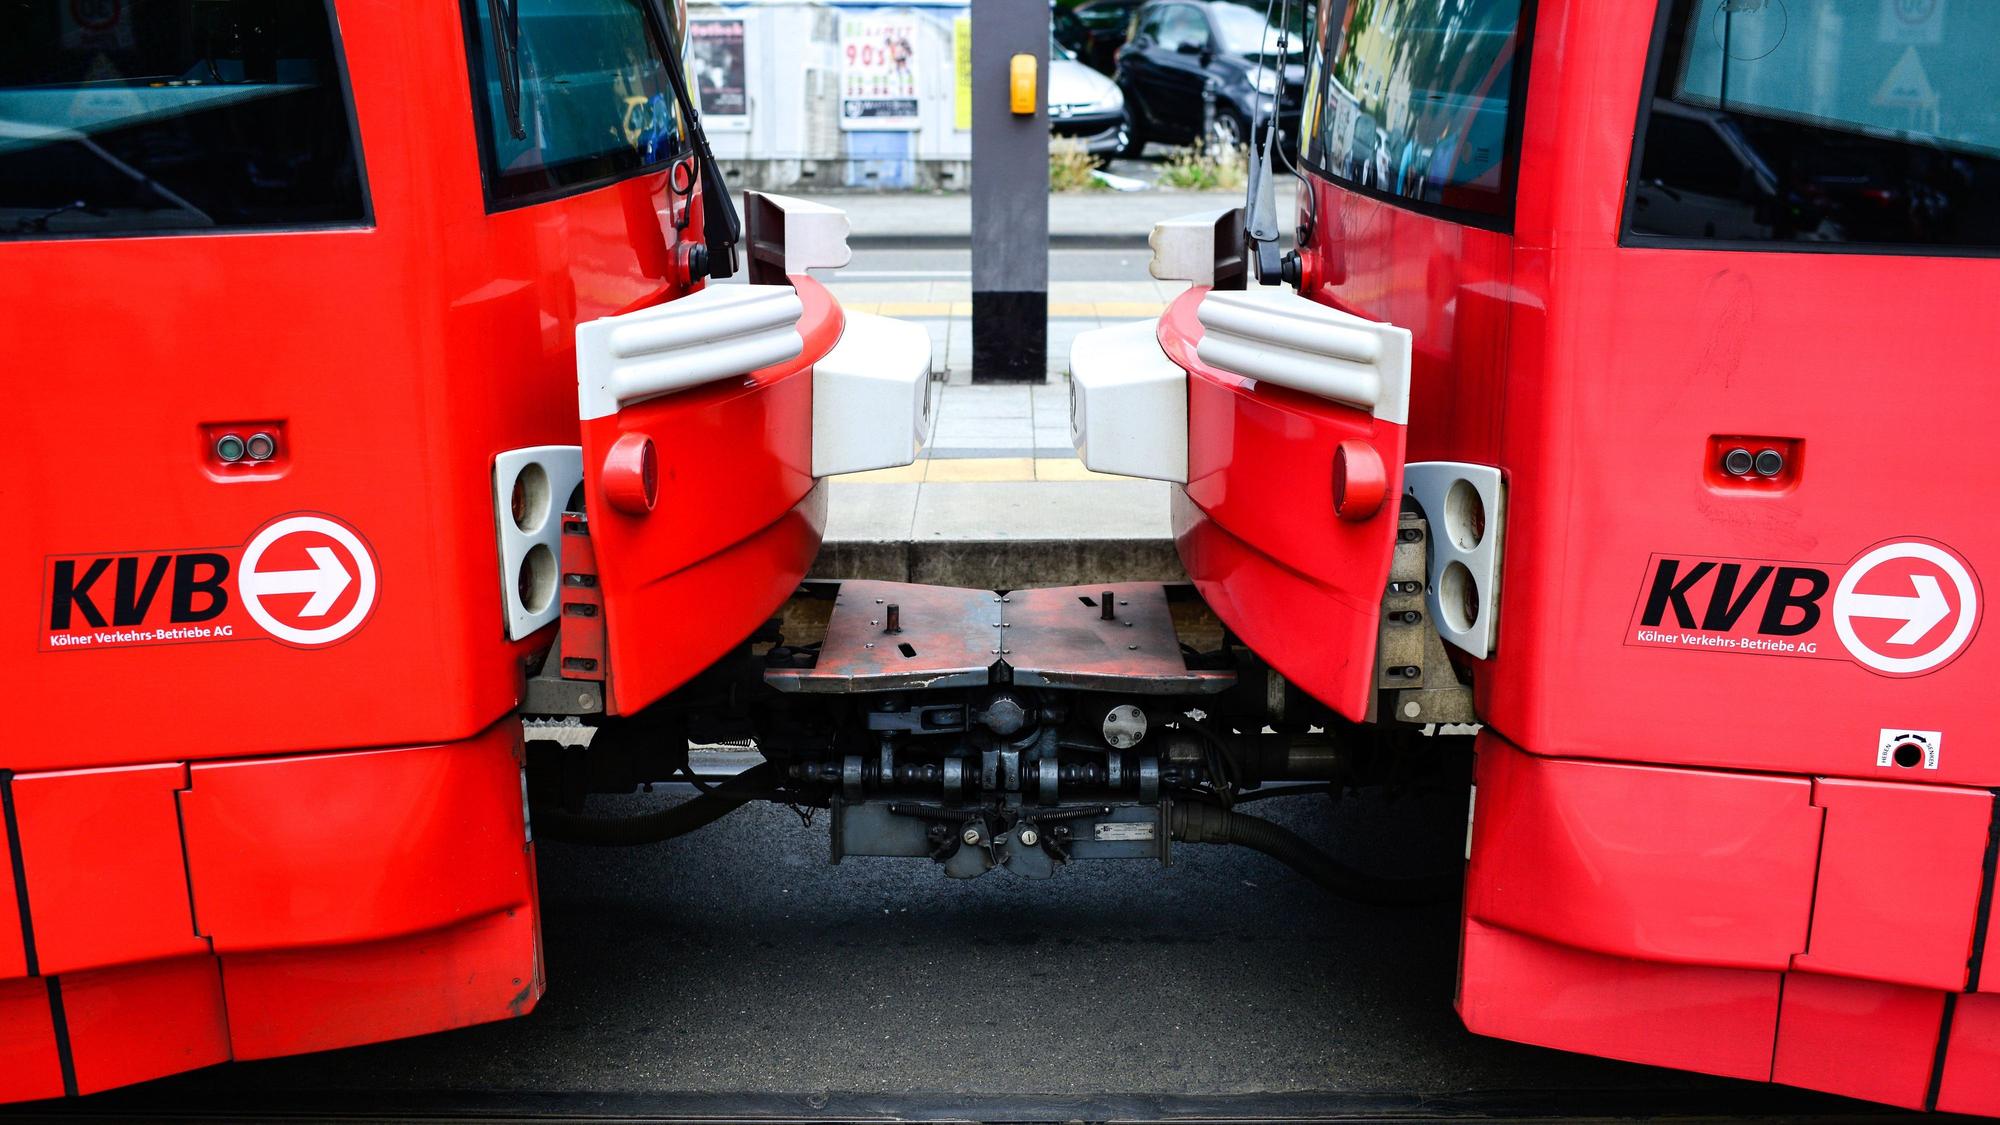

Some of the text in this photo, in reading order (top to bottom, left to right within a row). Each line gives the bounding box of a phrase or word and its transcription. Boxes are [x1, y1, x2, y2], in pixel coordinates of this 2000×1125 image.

[51, 553, 230, 631] KVB
[1640, 559, 1830, 636] KVB
[50, 625, 233, 647] Kölner Verkehrs-Betriebe AG
[1637, 630, 1817, 653] Kölner Verkehrs-Betriebe AG
[1881, 743, 1891, 764] HEBEN
[1926, 743, 1936, 767] SENKEN
